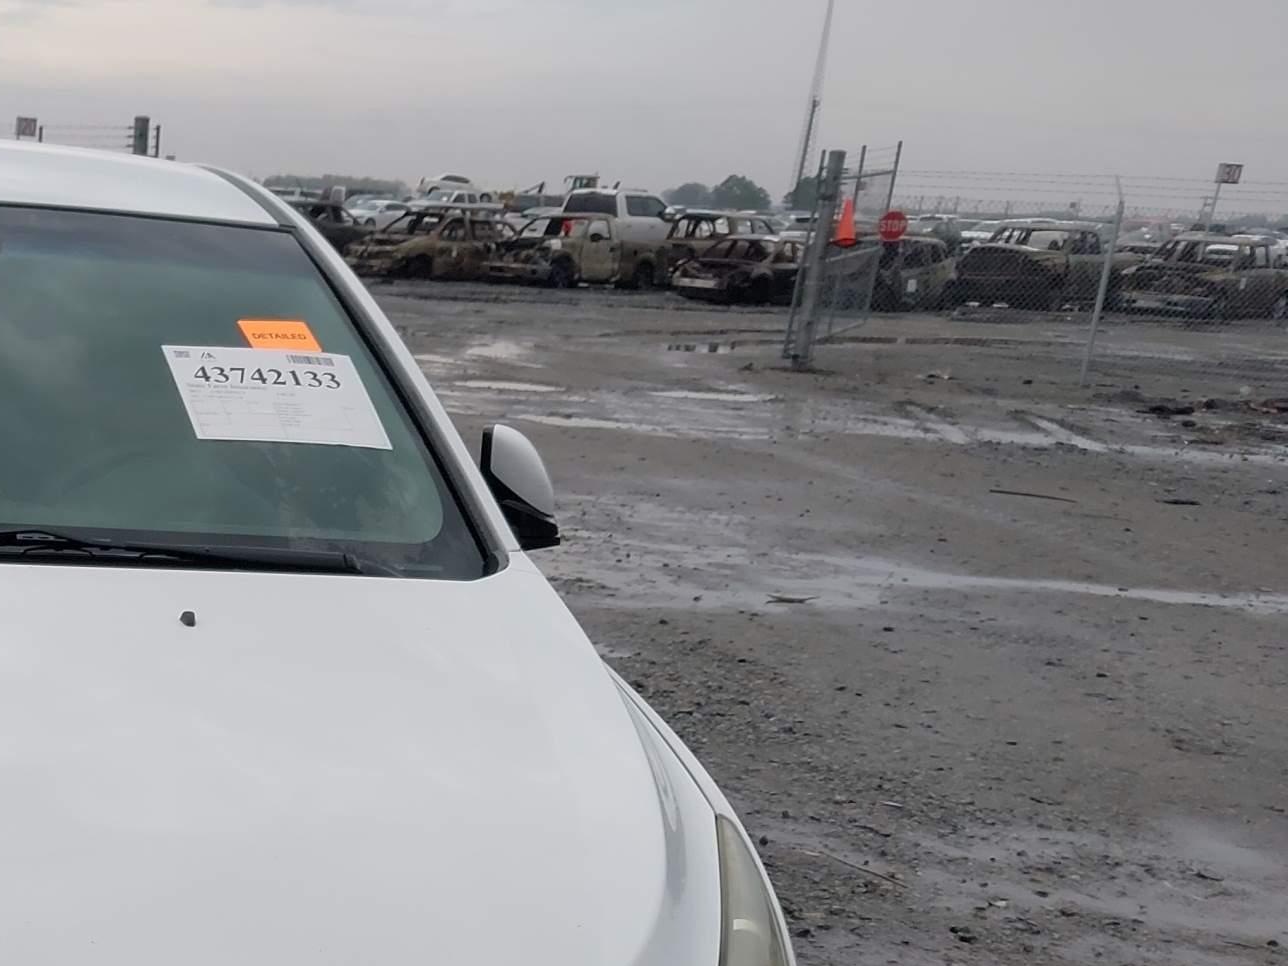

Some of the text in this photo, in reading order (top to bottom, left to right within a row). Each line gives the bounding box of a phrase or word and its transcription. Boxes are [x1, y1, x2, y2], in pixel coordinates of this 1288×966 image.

[880, 219, 906, 231] STOP
[252, 332, 307, 341] DETAILED
[194, 365, 341, 390] 43742133
